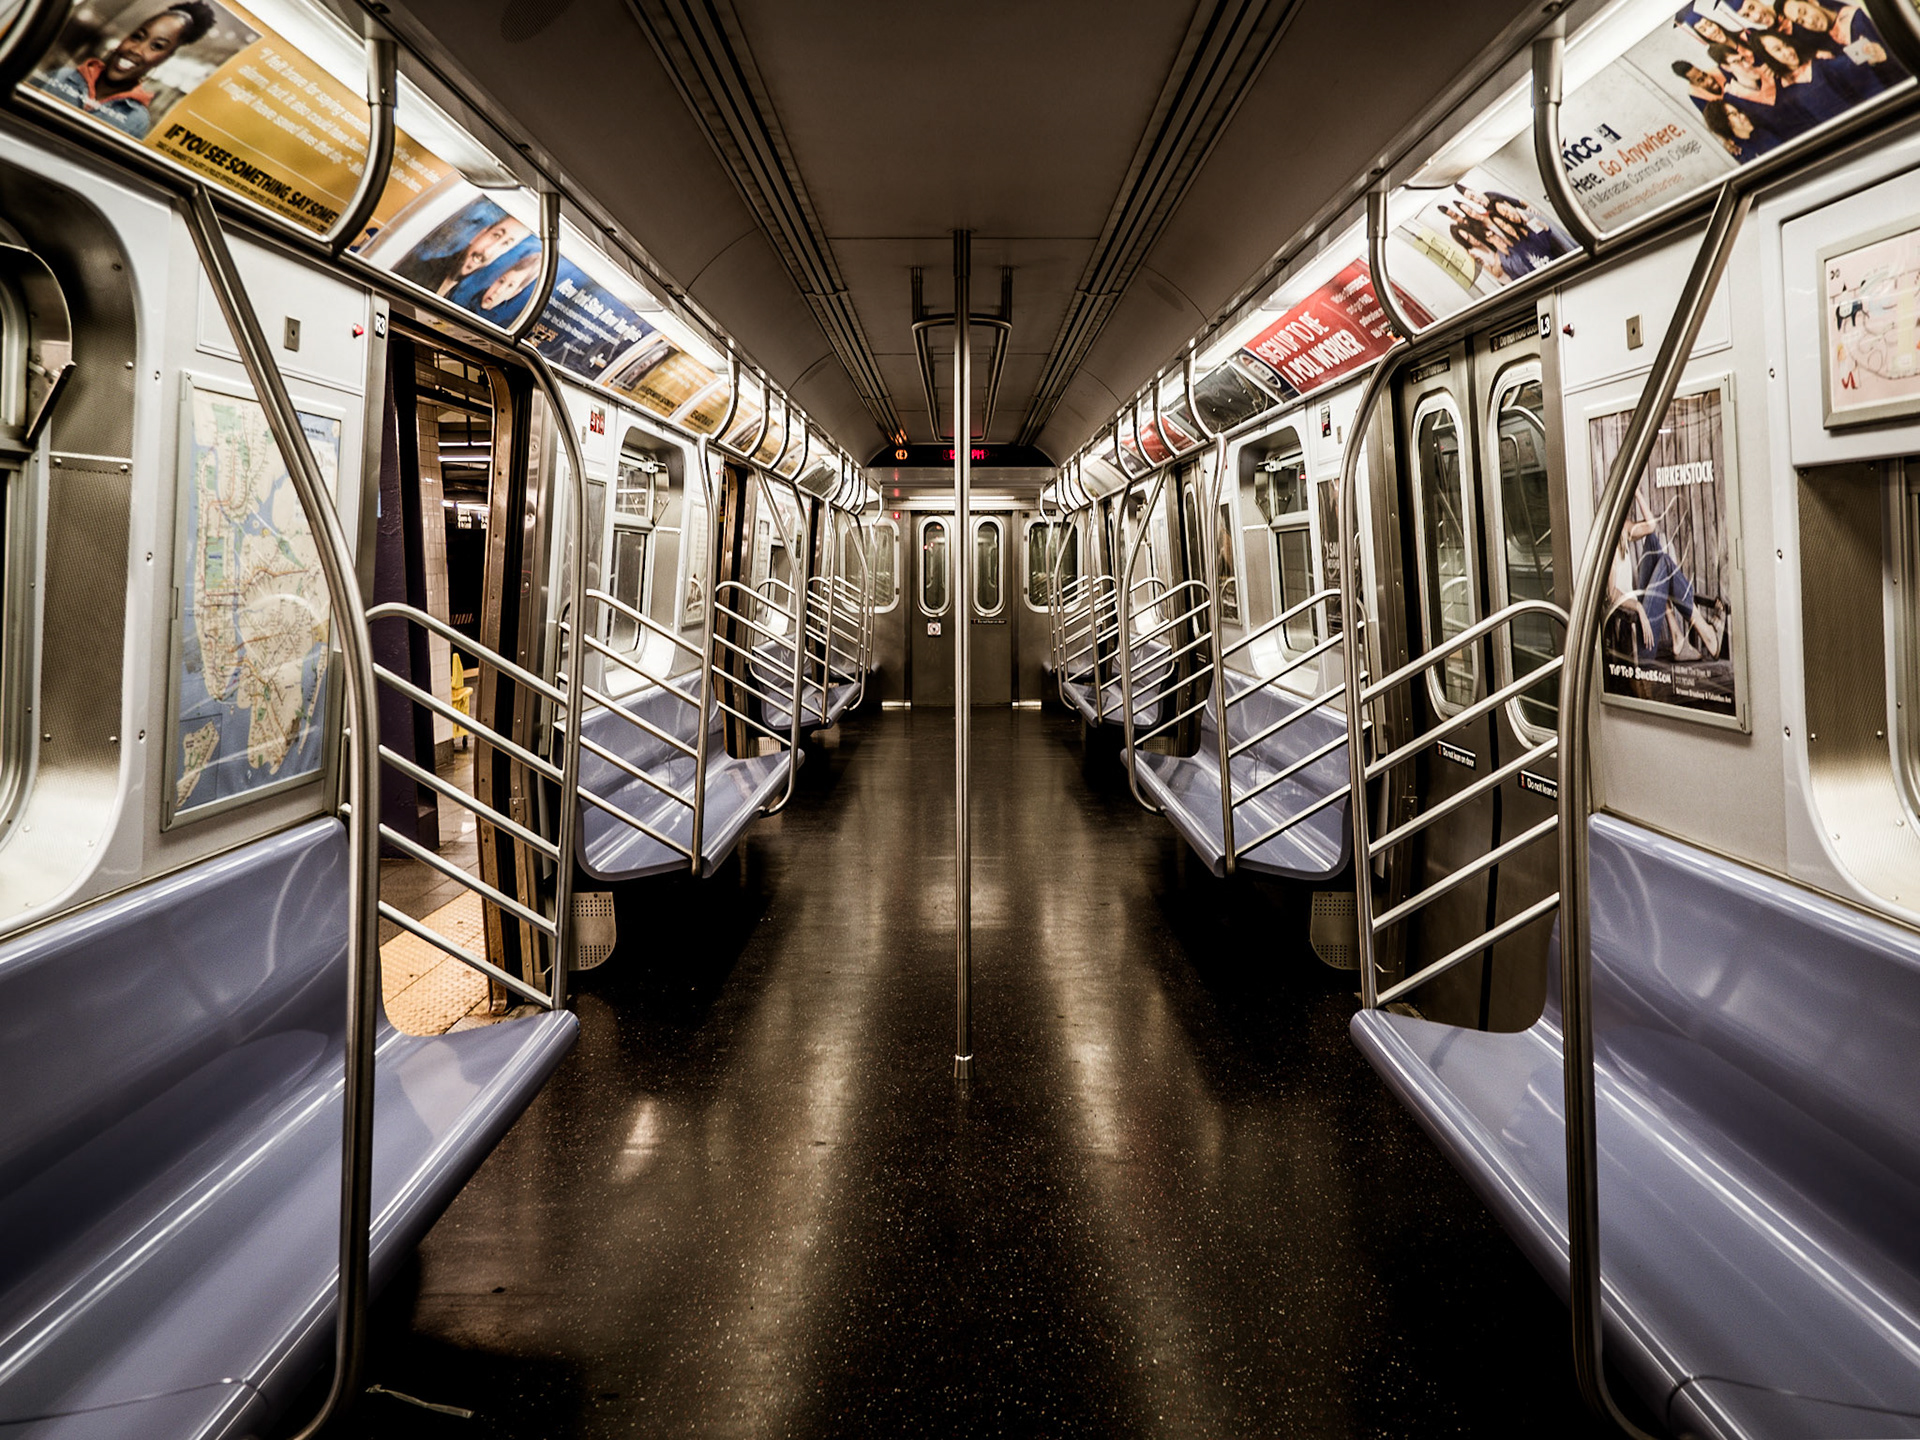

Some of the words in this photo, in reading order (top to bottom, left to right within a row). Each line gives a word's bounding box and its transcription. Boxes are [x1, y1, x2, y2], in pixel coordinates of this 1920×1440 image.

[1598, 160, 1622, 177] Go
[1617, 124, 1686, 167] Anywhere.
[164, 123, 185, 140] IF
[179, 130, 210, 155] YOU
[204, 145, 233, 168] SEE
[288, 191, 312, 213] SAY
[1627, 157, 1674, 184] Community
[1285, 321, 1315, 344] TO
[1298, 311, 1329, 336] BE
[1540, 316, 1550, 335] L3
[1256, 337, 1291, 365] SIGN
[1273, 329, 1301, 352] UP
[1308, 329, 1366, 370] WORKER
[1282, 365, 1303, 386] A
[1288, 353, 1324, 381] POLL
[1656, 460, 1713, 488] BIRKENSTOCK
[1453, 751, 1461, 762] lean
[1466, 757, 1475, 767] door
[1527, 778, 1534, 789] Do
[1534, 782, 1543, 793] not
[1543, 783, 1553, 796] lean
